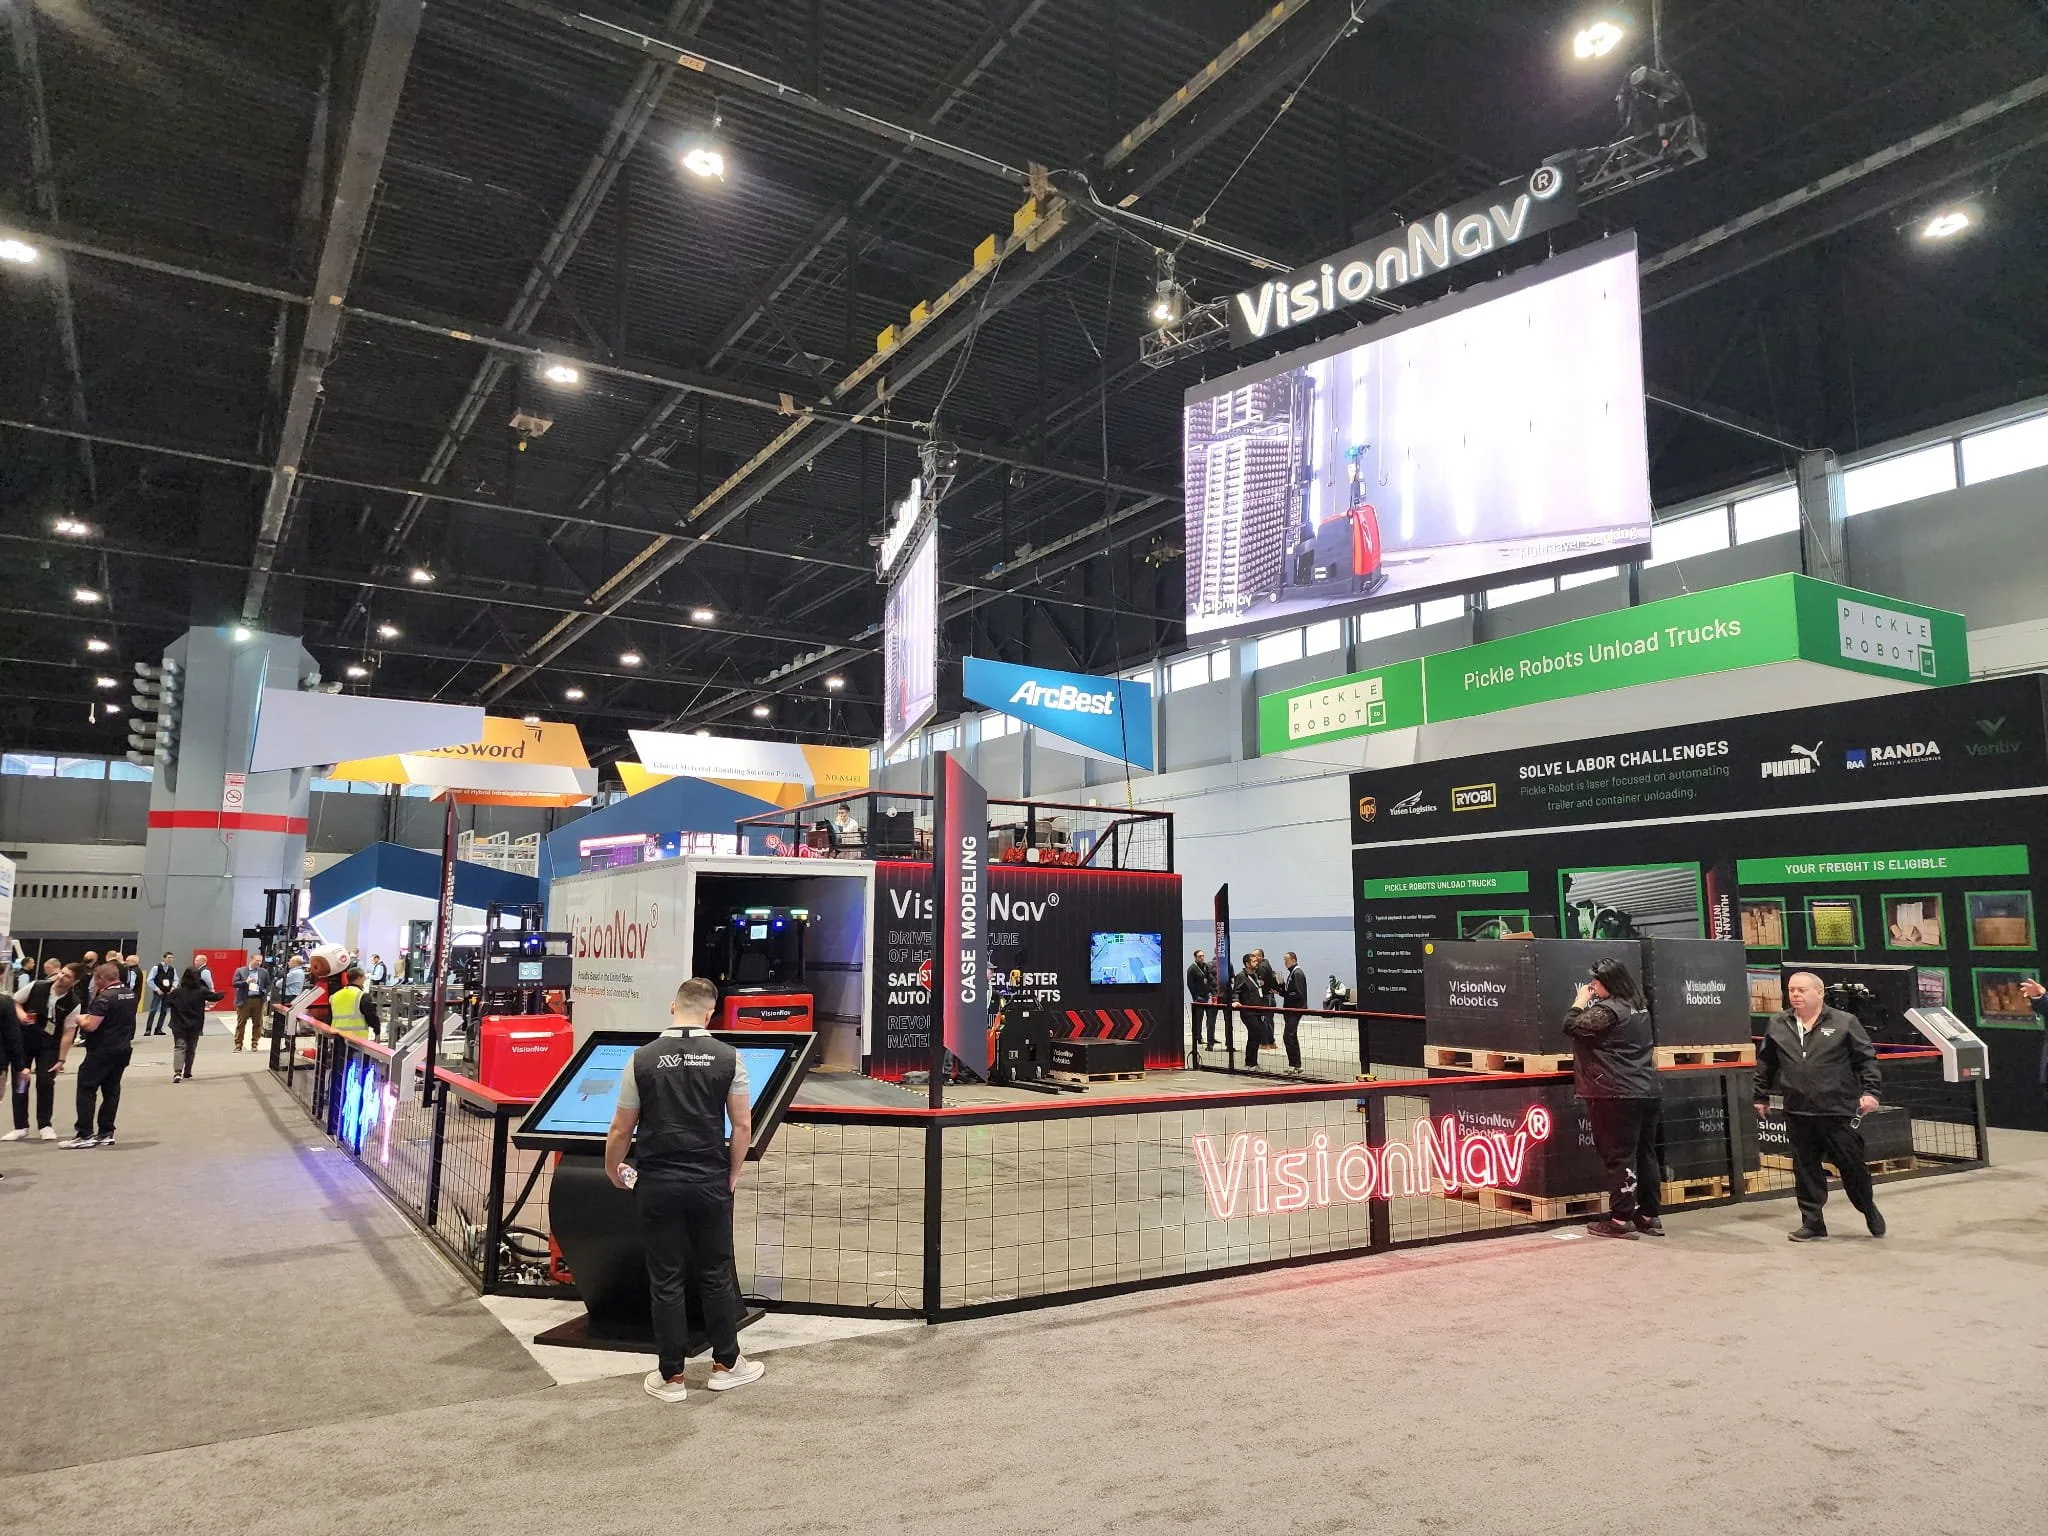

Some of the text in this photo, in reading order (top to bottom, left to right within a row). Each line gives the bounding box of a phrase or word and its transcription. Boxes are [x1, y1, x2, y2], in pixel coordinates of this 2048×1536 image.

[1843, 607, 1926, 638] PICKLE
[1464, 618, 1741, 691] Pickle Robots Unload Trucks
[1845, 636, 1914, 662] ROBOT
[1009, 680, 1117, 715] ArcBest
[1293, 684, 1378, 713] PICKLE
[1293, 710, 1362, 733] ROBOT
[1871, 741, 1940, 761] RANDA
[1519, 740, 1729, 780] SOLVE LABOR CHALLENGES
[1846, 760, 1865, 769] RAA
[745, 767, 775, 777] Solution
[1520, 765, 1730, 797] Pickle Robot is laser focused on automating
[1456, 790, 1492, 805] RYOBI
[1548, 787, 1697, 811] trailer and container unloading.
[1361, 804, 1376, 818] ups
[1409, 804, 1437, 815] Logistics
[1785, 857, 1947, 875] YOUR FREIGHT IS ELIGIBLE
[1385, 878, 1497, 892] PICKLE ROBOTS UNLOAD TRUCKS
[961, 836, 977, 1003] CASE MODELING
[1449, 980, 1507, 994] VisionNav
[1686, 979, 1727, 992] VisionNav
[1449, 994, 1499, 1008] Robotics
[1686, 993, 1722, 1005] Robotics
[761, 1009, 791, 1017] VisionNav
[512, 1045, 549, 1053] VisionNav
[683, 1053, 716, 1061] VisionNav
[1458, 1109, 1516, 1129] VisionNav
